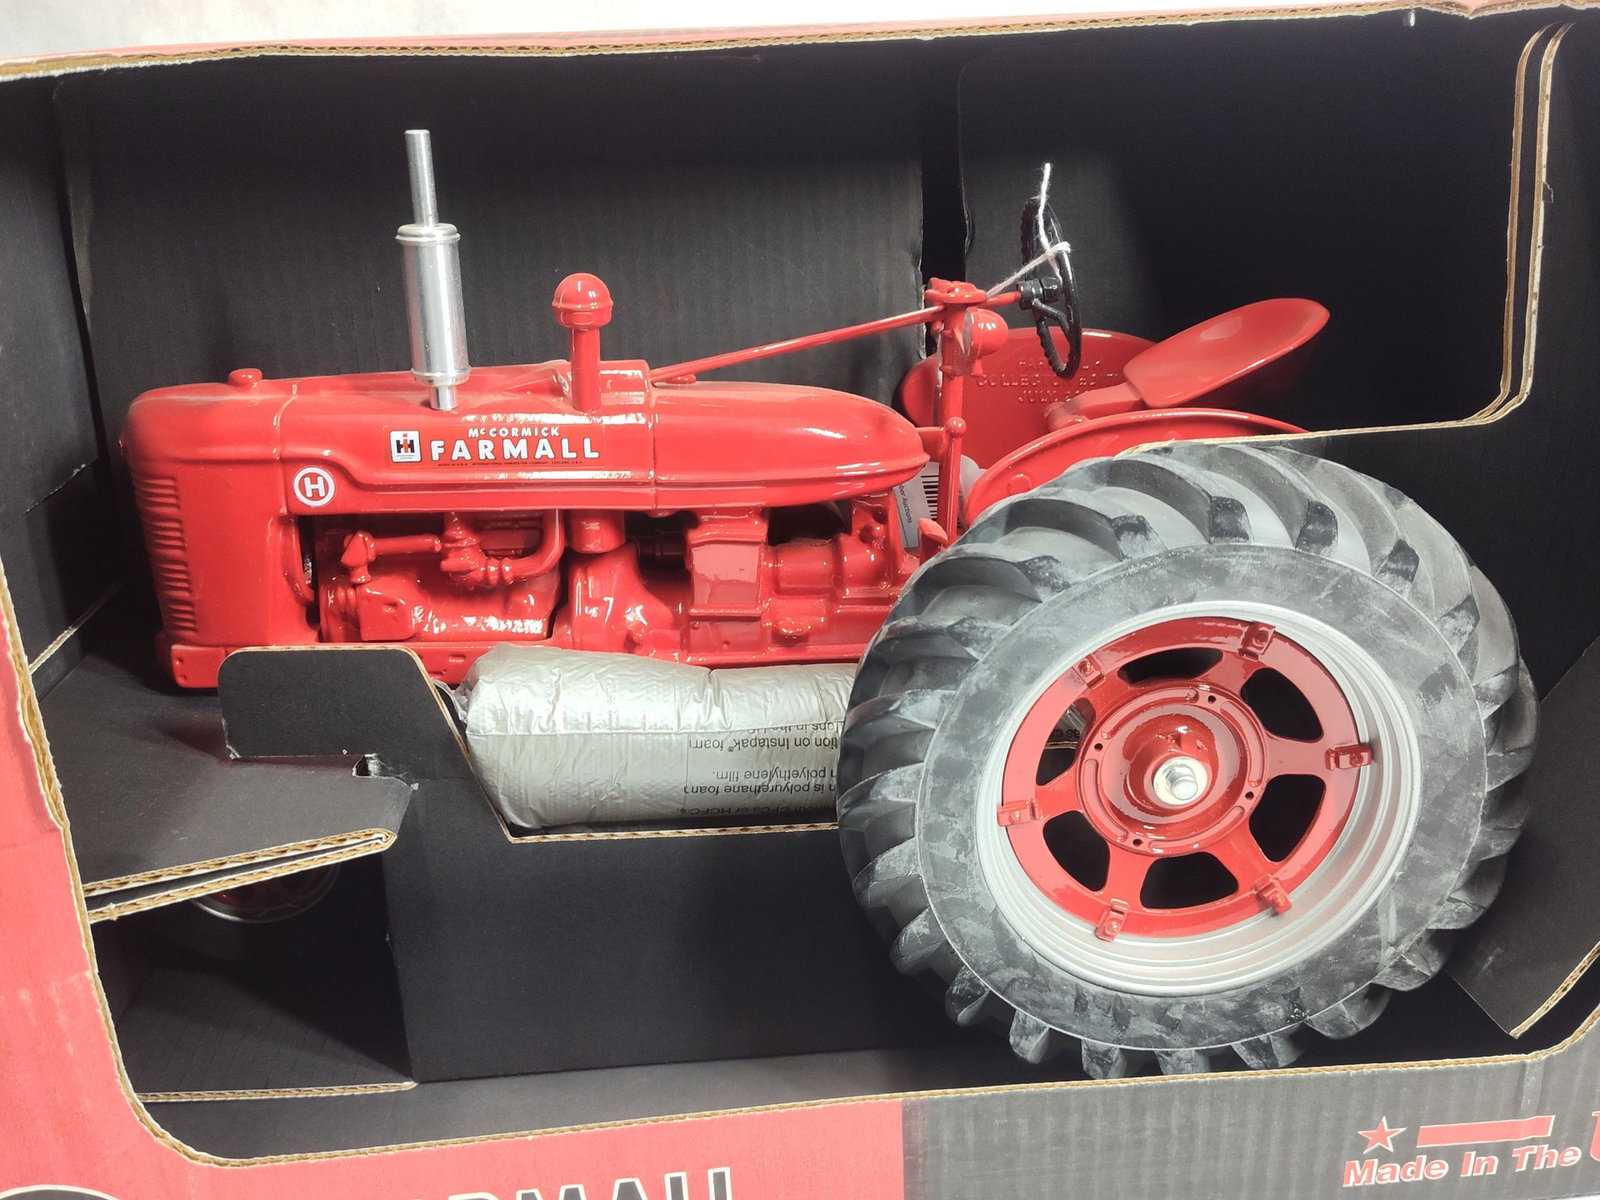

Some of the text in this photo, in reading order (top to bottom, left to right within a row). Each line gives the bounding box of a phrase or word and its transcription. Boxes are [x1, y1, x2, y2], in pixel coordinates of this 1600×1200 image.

[430, 437, 600, 461] FARMALL
[304, 477, 326, 498] H
[902, 497, 912, 523] Auctions
[689, 738, 724, 752] foam
[794, 737, 811, 748] on
[814, 737, 839, 750] tion
[712, 771, 741, 782] film.
[744, 766, 827, 782] polyethylene
[724, 781, 810, 795] polyurethane
[814, 783, 825, 794] is
[1343, 1144, 1582, 1188] Made In The
